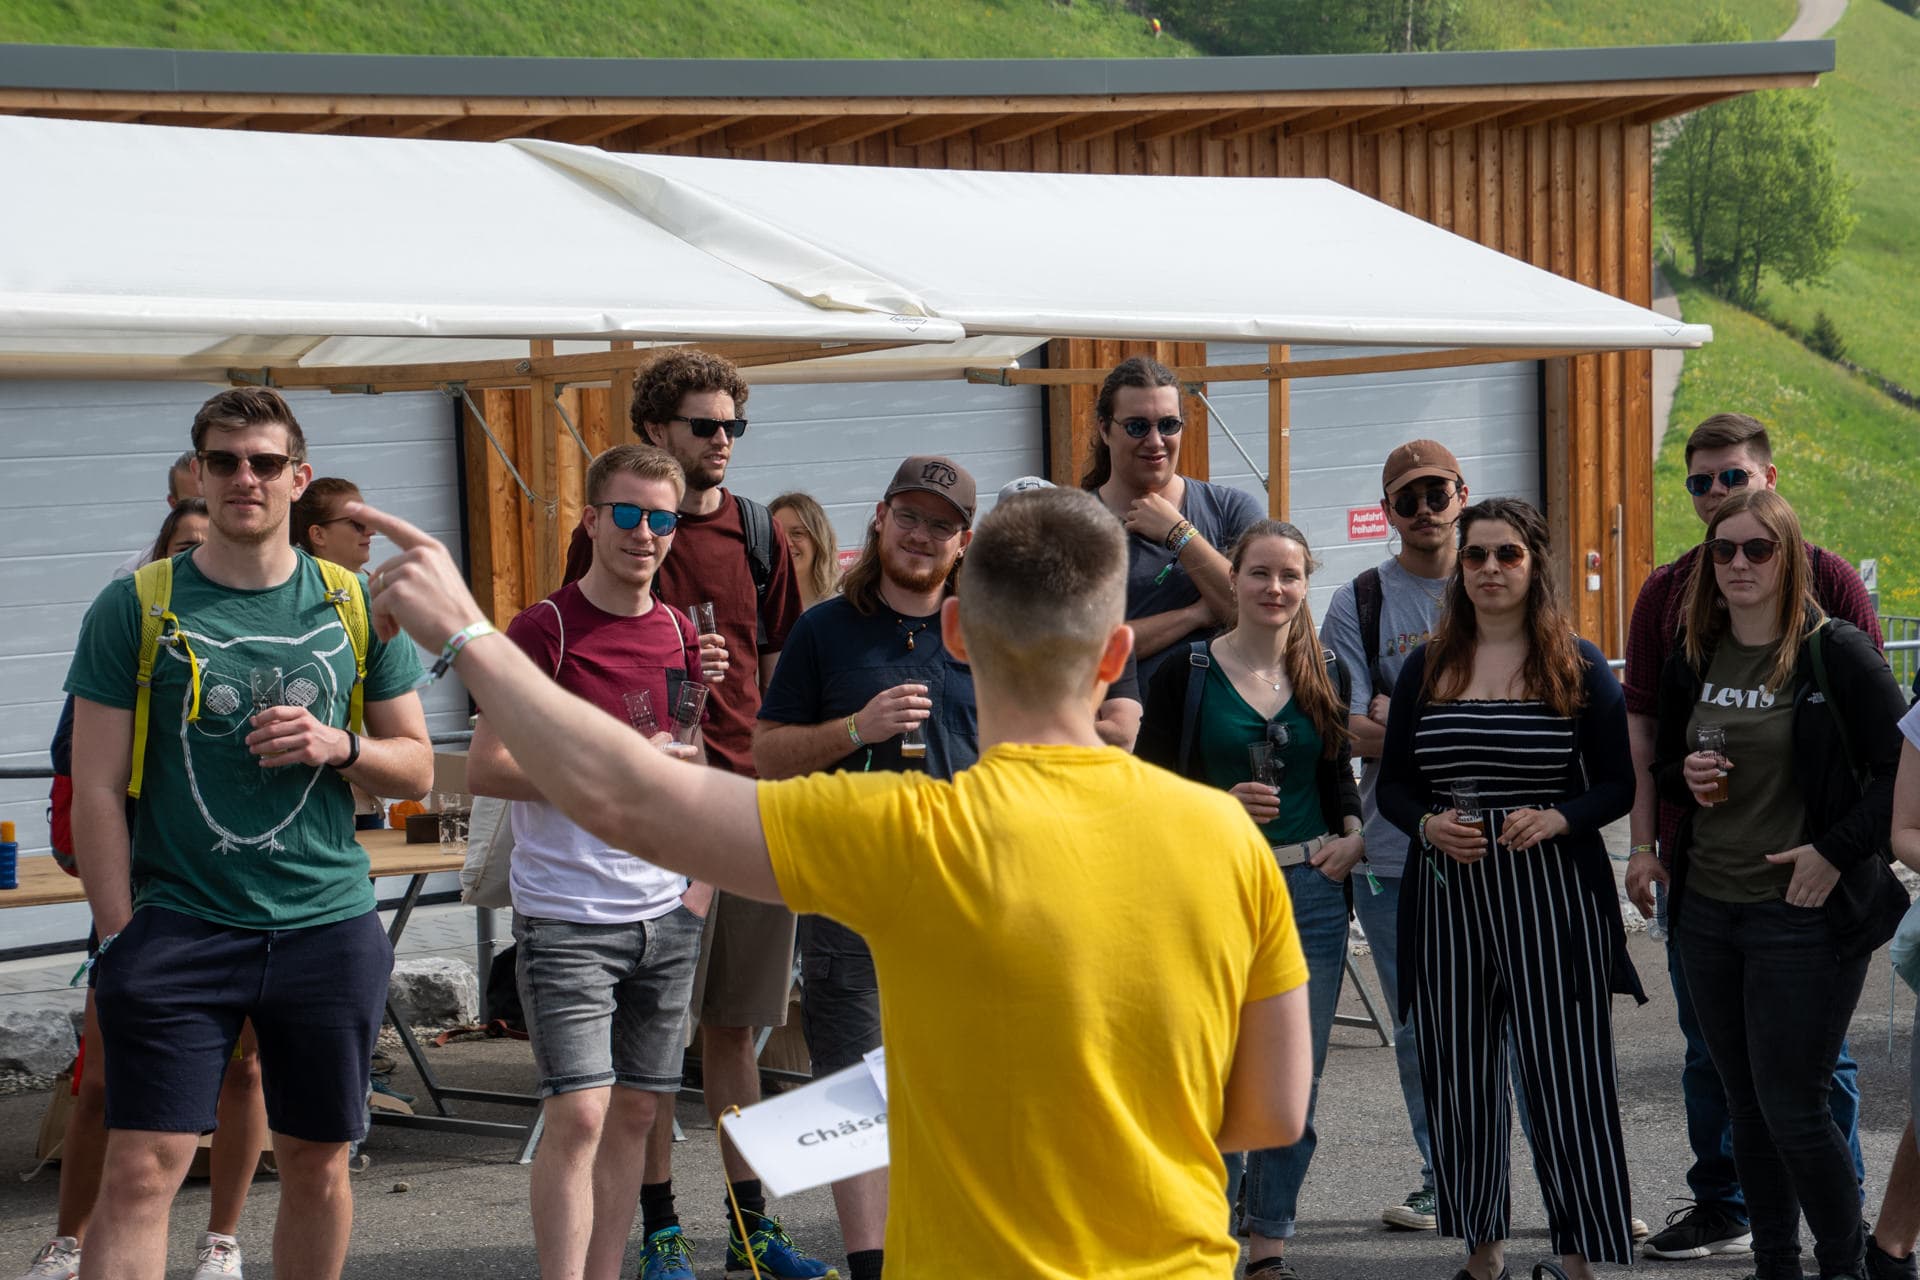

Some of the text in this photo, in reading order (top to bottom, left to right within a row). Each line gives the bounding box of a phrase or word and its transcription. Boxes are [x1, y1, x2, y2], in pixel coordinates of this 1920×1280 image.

[921, 463, 957, 486] 1779
[1353, 511, 1384, 523] Ausfahrt
[1351, 523, 1385, 535] freihalten
